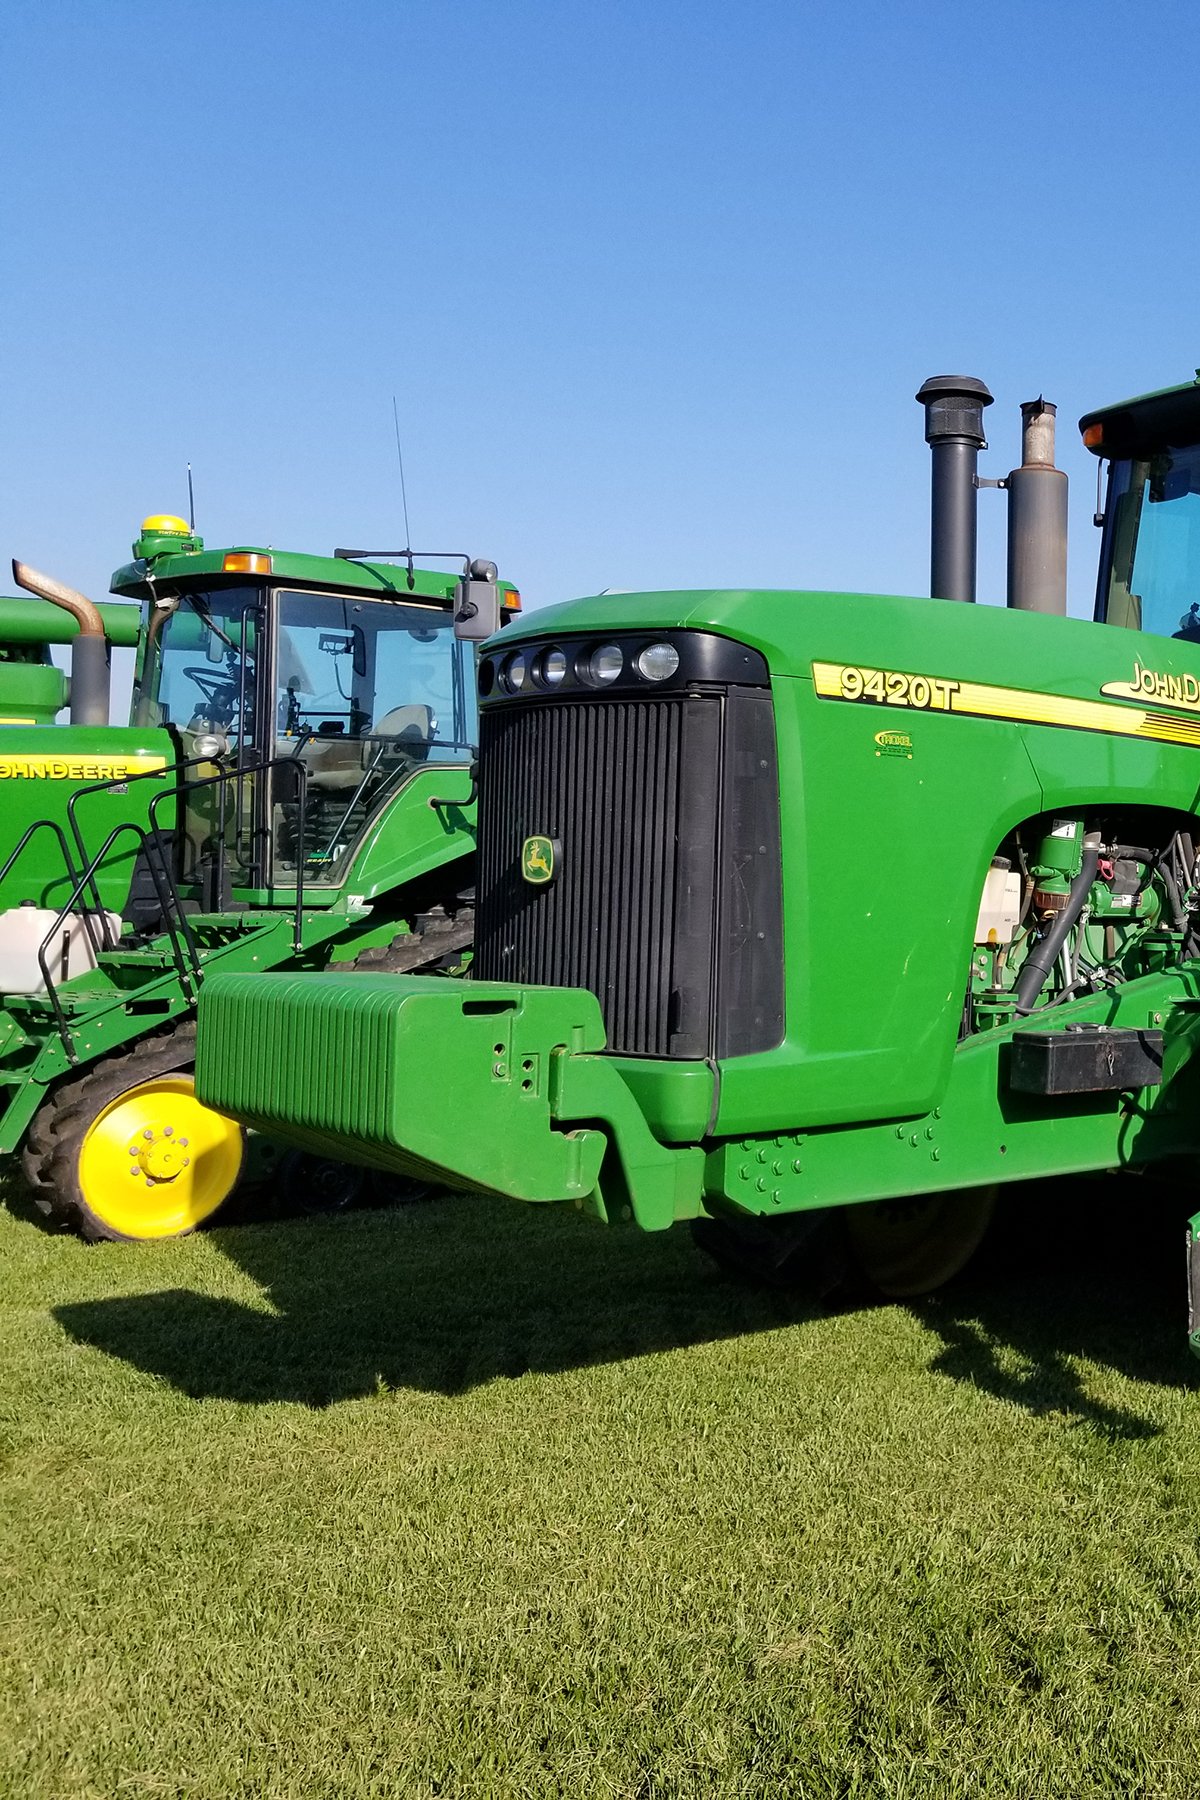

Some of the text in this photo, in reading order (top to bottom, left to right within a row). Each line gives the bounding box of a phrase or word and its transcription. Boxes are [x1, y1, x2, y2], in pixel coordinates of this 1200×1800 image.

[840, 666, 960, 710] 9420T
[1130, 662, 1183, 700] JOHN
[0, 760, 127, 780] OHN DEERE
